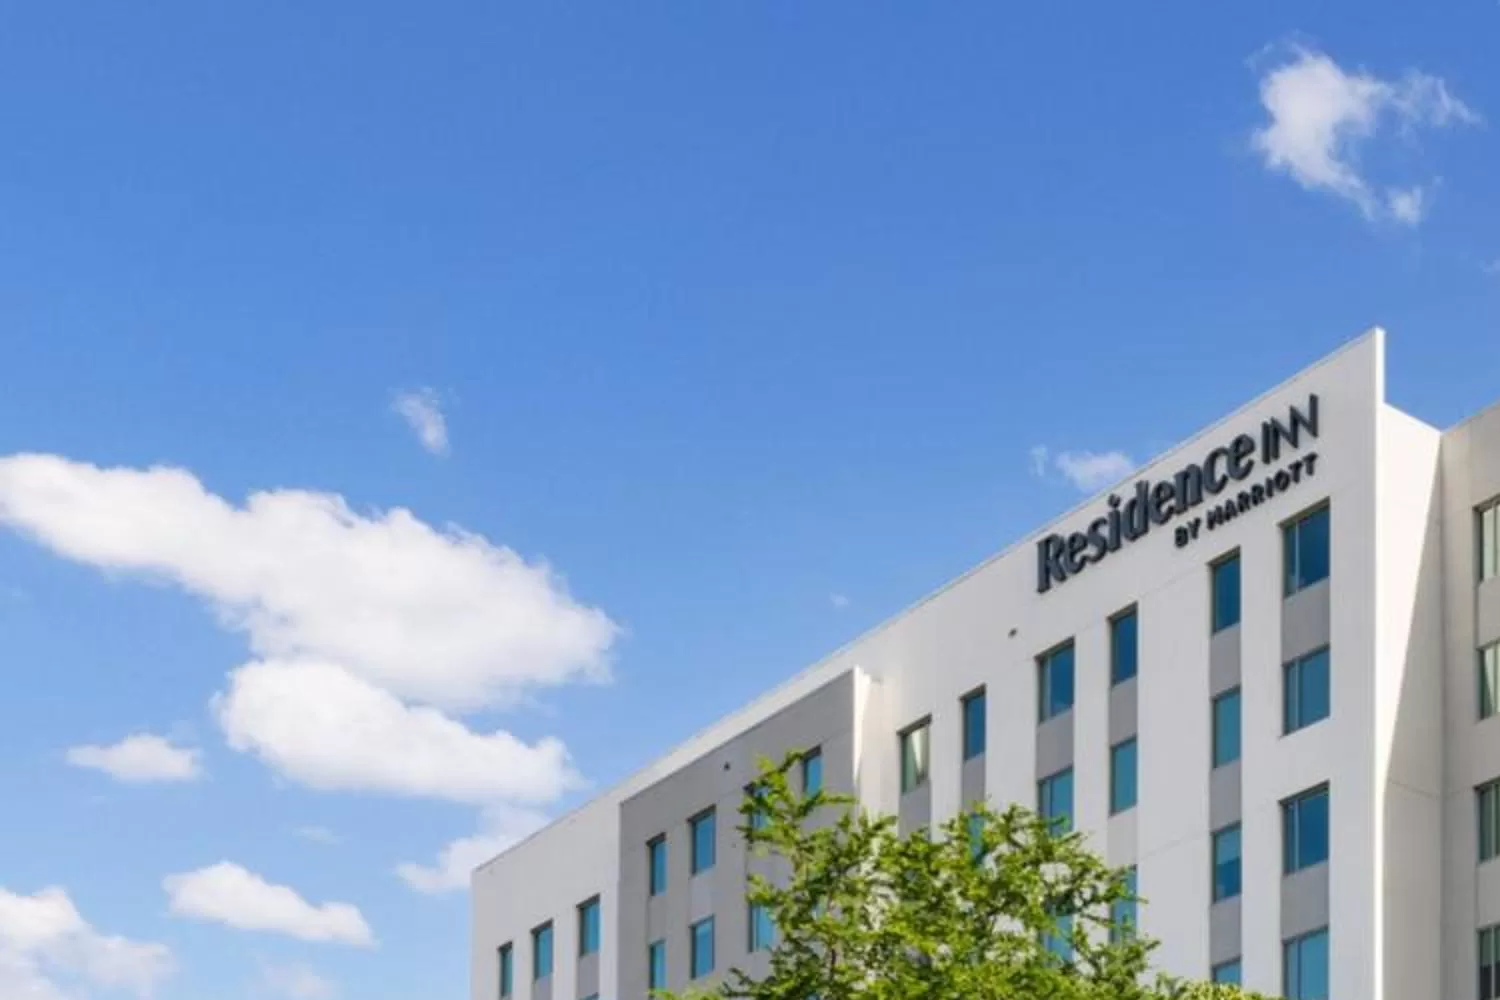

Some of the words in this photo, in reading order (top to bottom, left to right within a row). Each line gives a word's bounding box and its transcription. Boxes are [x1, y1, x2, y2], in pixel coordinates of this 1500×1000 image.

[1037, 433, 1255, 594] Residence
[1261, 393, 1319, 464] INN
[1174, 517, 1202, 548] BY
[1206, 452, 1318, 531] MARRIOTT
